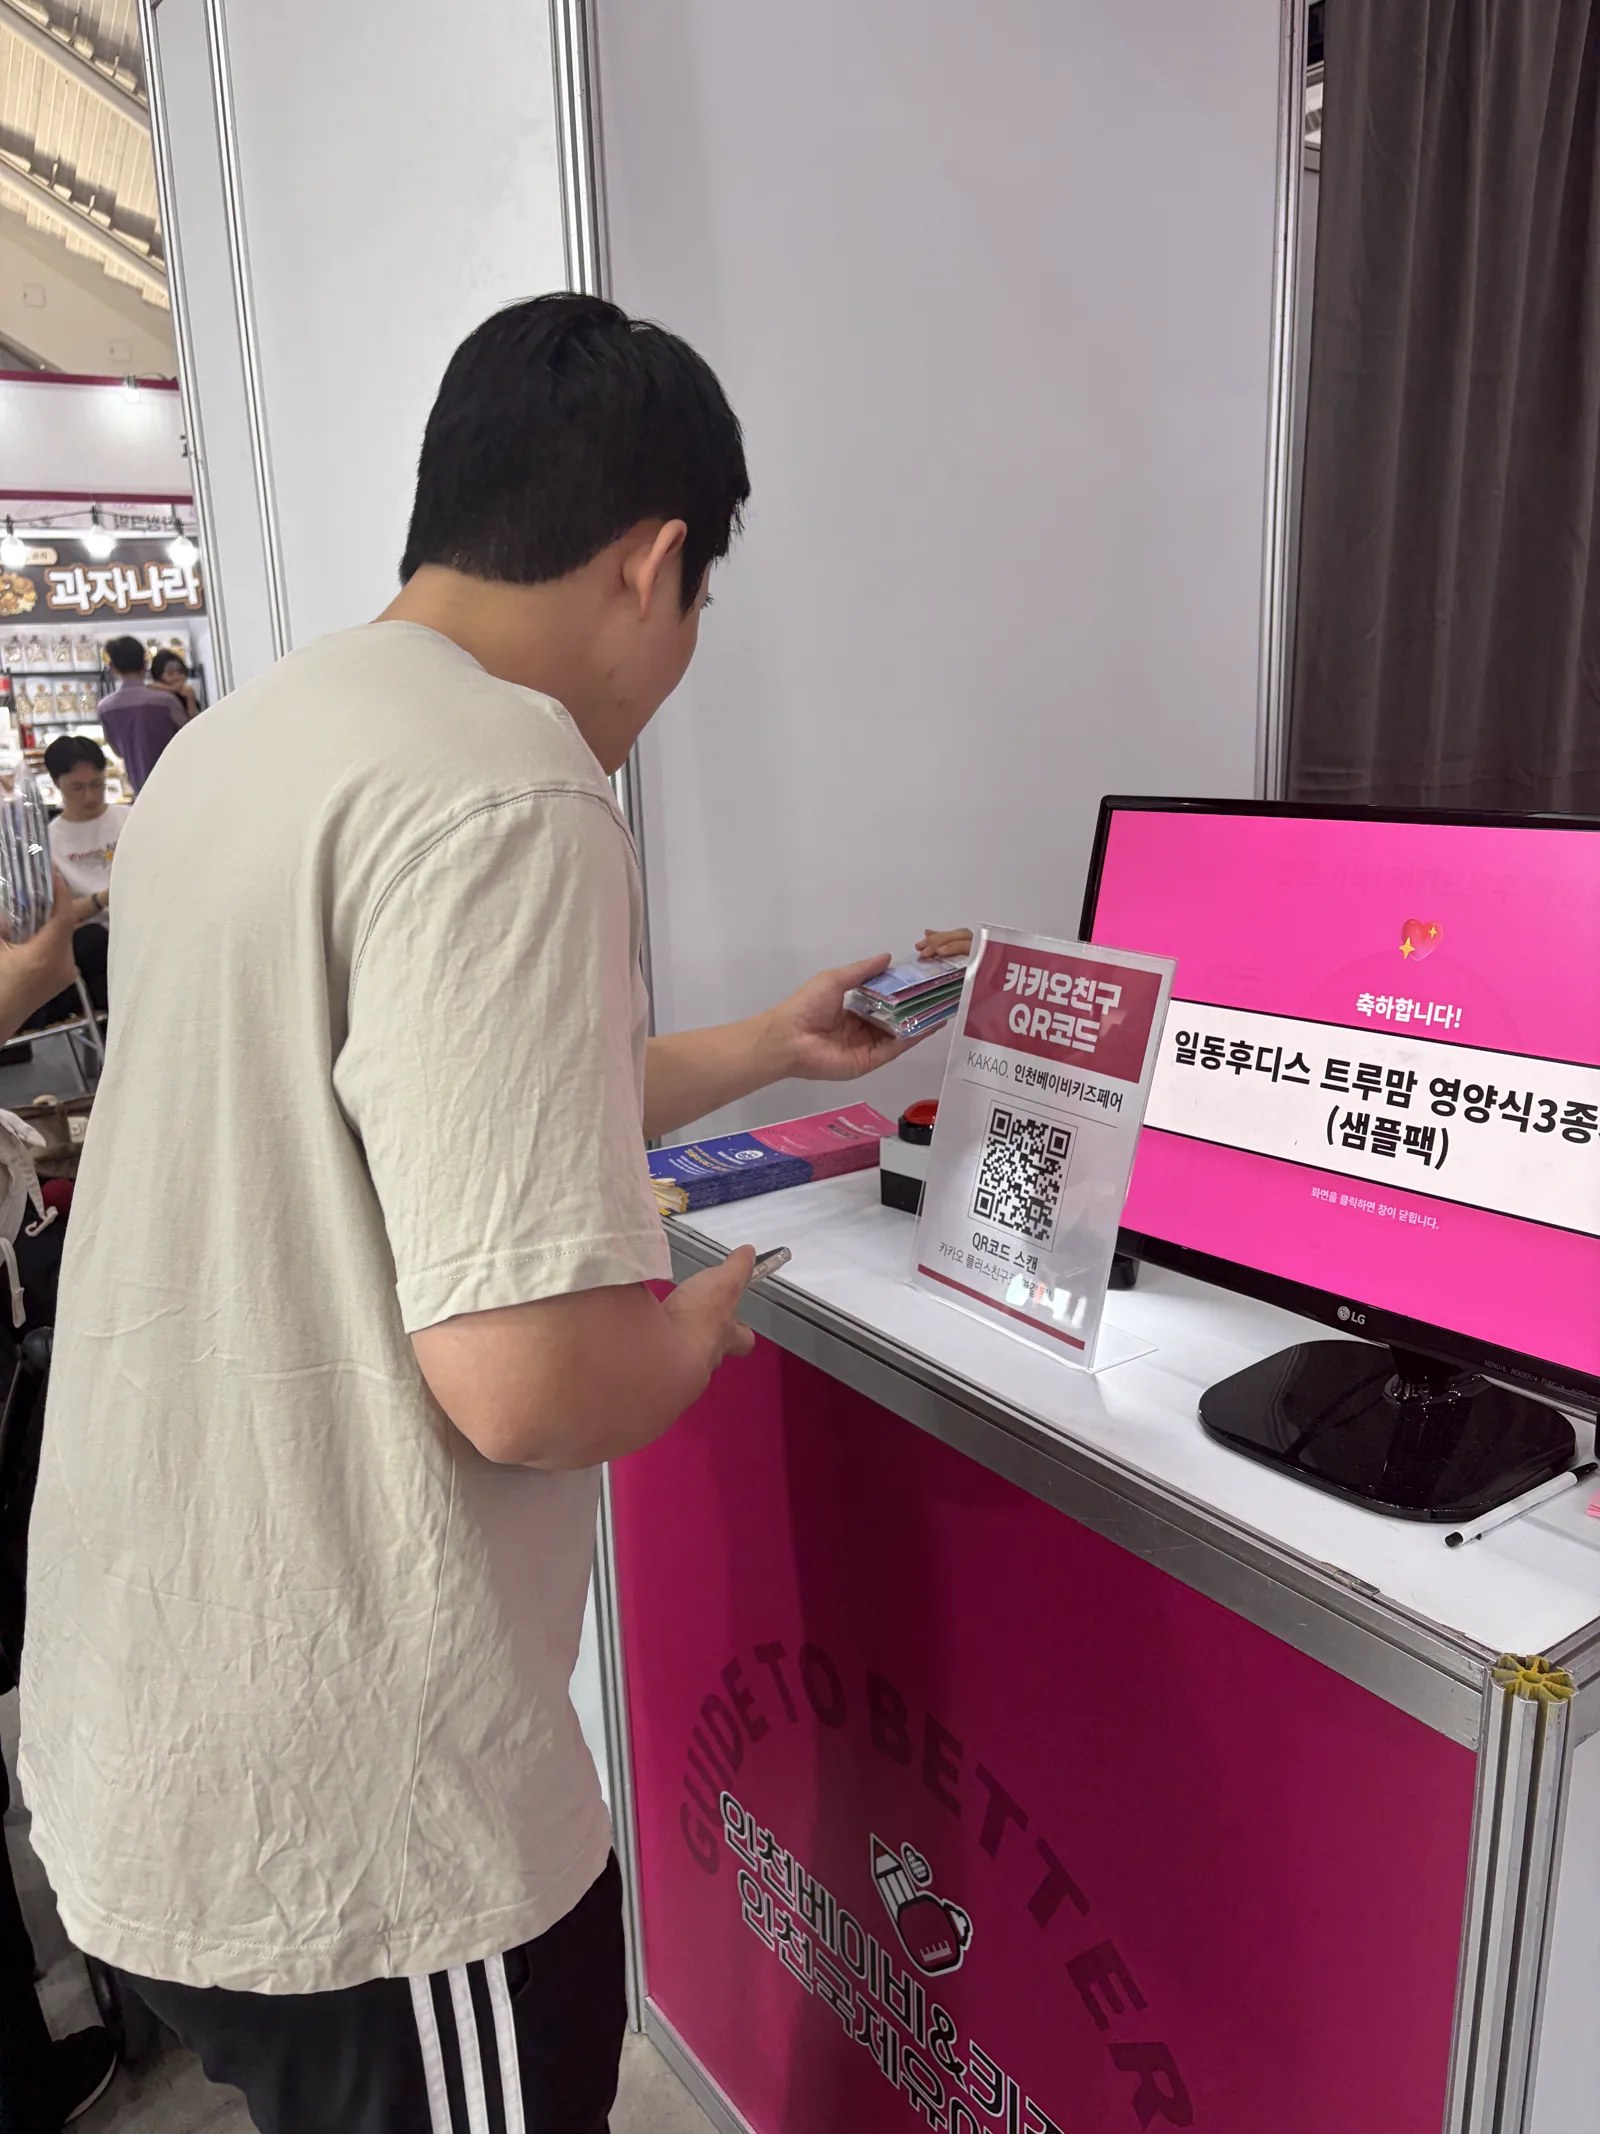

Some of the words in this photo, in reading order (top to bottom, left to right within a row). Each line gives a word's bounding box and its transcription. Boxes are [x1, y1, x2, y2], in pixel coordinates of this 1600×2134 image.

[48, 566, 200, 611] 과자나라
[1003, 962, 1122, 1016] 카카오친구
[1356, 993, 1462, 1028] 축하합니다!
[1009, 1003, 1100, 1053] QR코드
[1014, 1064, 1123, 1112] 인천베이비키즈페어
[1174, 1030, 1311, 1086] 일동후디스
[1320, 1057, 1418, 1110] 트루맘
[1429, 1076, 1600, 1145] 영양식3종
[1326, 1105, 1449, 1170] (샘플팩)
[1311, 1186, 1338, 1204] 화면을
[1339, 1194, 1376, 1214] 클릭하면
[1377, 1203, 1397, 1219] 창이
[1399, 1209, 1440, 1230] 닫힙니다.
[938, 1242, 964, 1263] 카카오
[972, 1232, 1010, 1262] QR코드
[1013, 1251, 1039, 1275] 스캔
[1350, 1311, 1366, 1325] LG
[681, 1657, 771, 1876] GUIDE
[754, 1640, 848, 1730] TO
[865, 1668, 1196, 2132] BETTER
